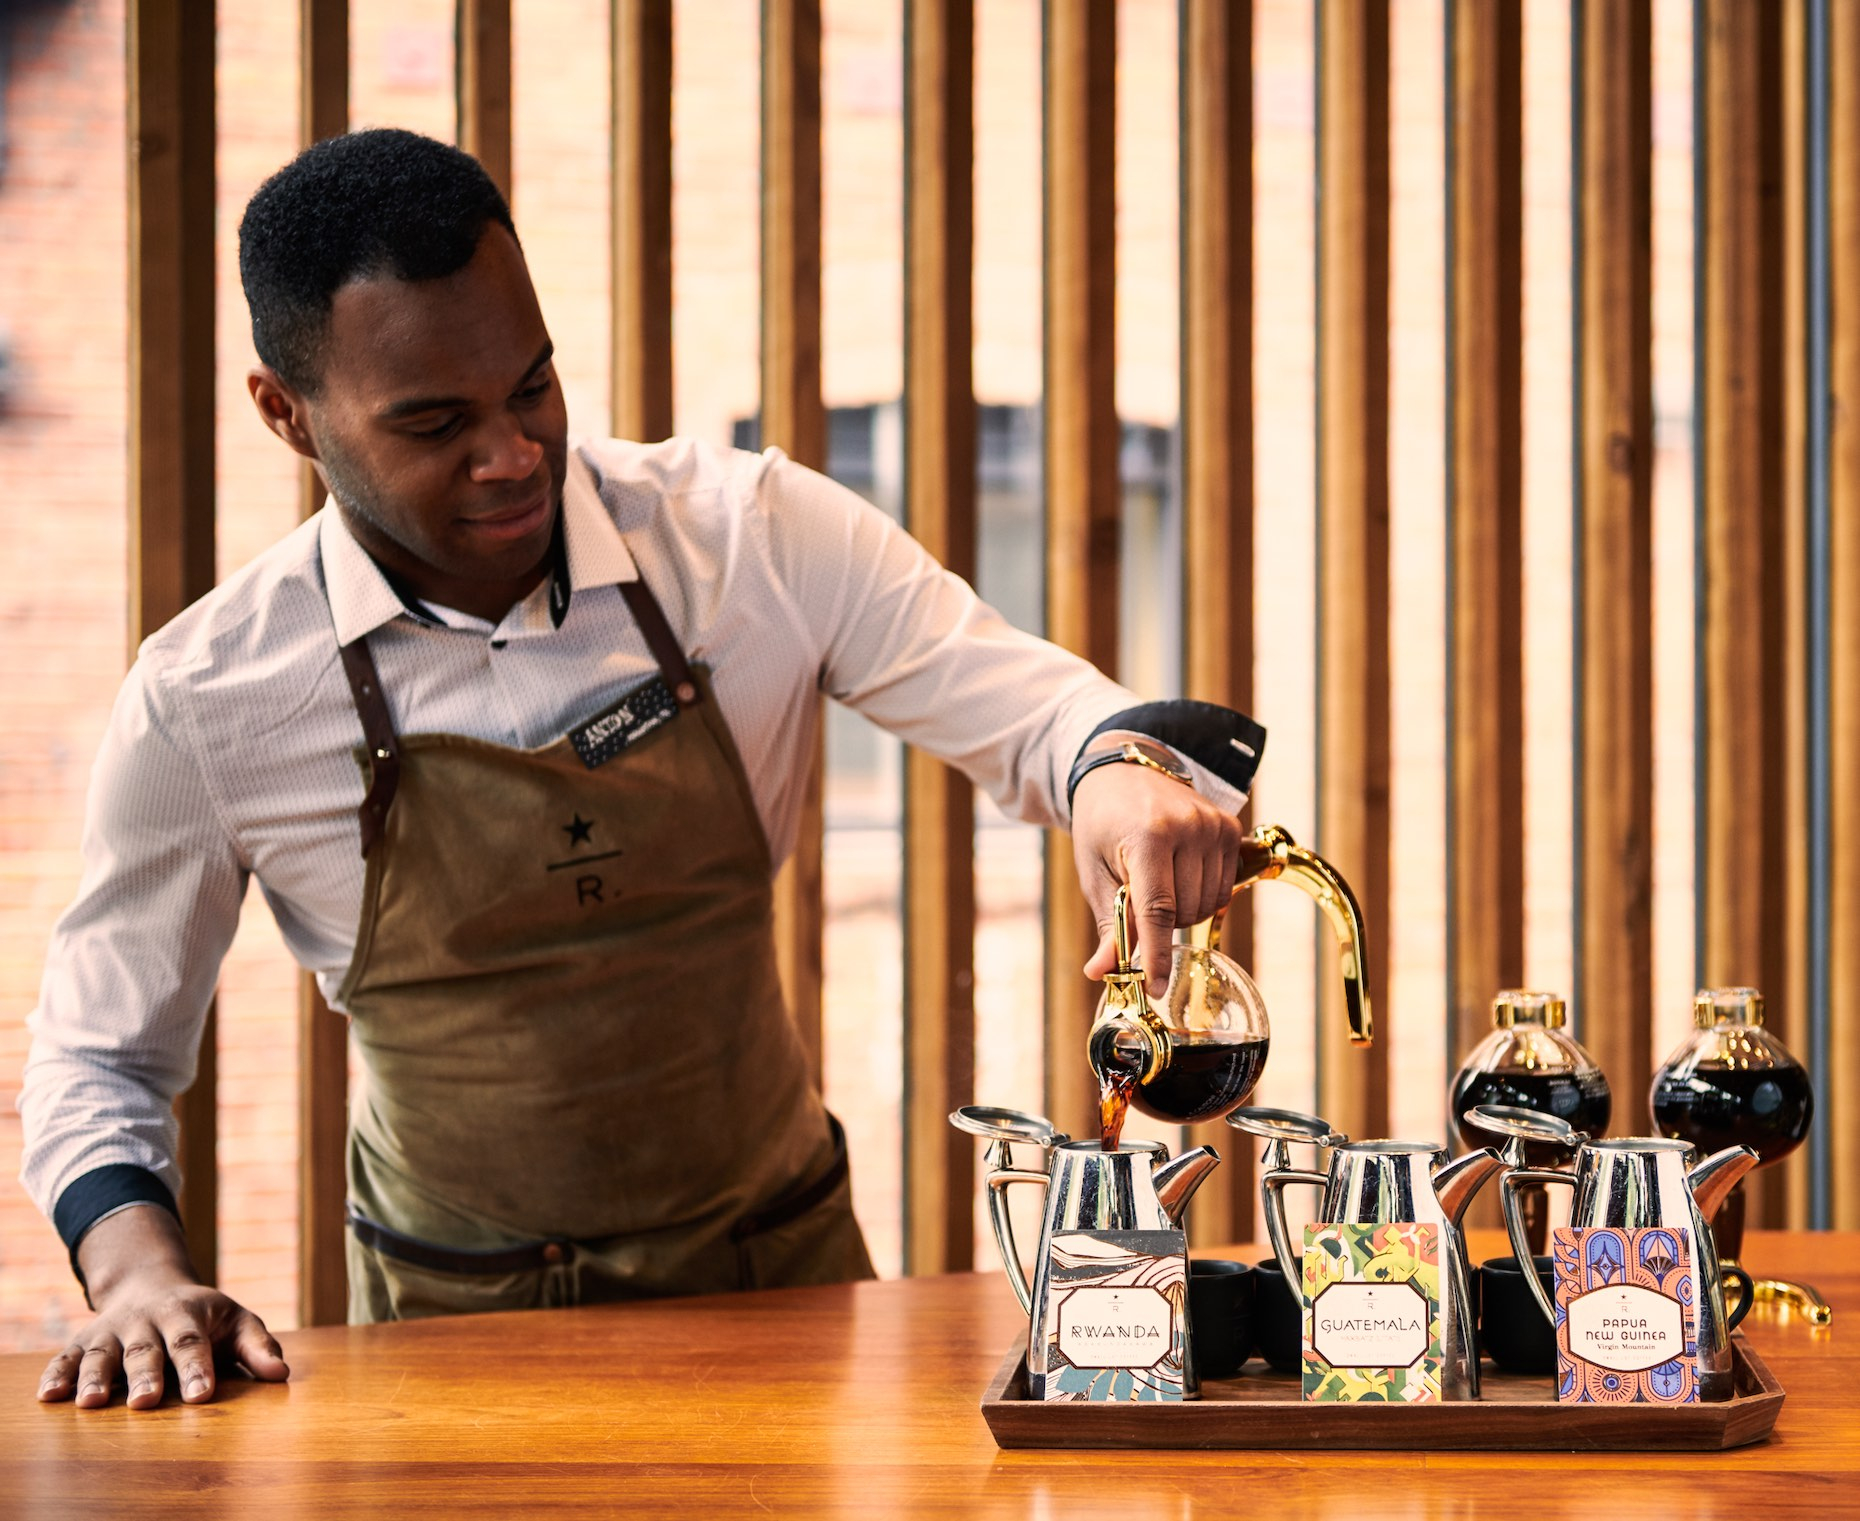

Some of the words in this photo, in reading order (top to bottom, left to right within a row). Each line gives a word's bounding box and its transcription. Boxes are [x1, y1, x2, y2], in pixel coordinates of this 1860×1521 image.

[1320, 1317, 1421, 1334] GUATEMALA
[1602, 1318, 1647, 1328] PAPUA
[1071, 1324, 1160, 1339] RWANDA
[1585, 1331, 1614, 1341] NEW
[1620, 1331, 1667, 1341] GUINEA
[1597, 1343, 1619, 1352] Virgin
